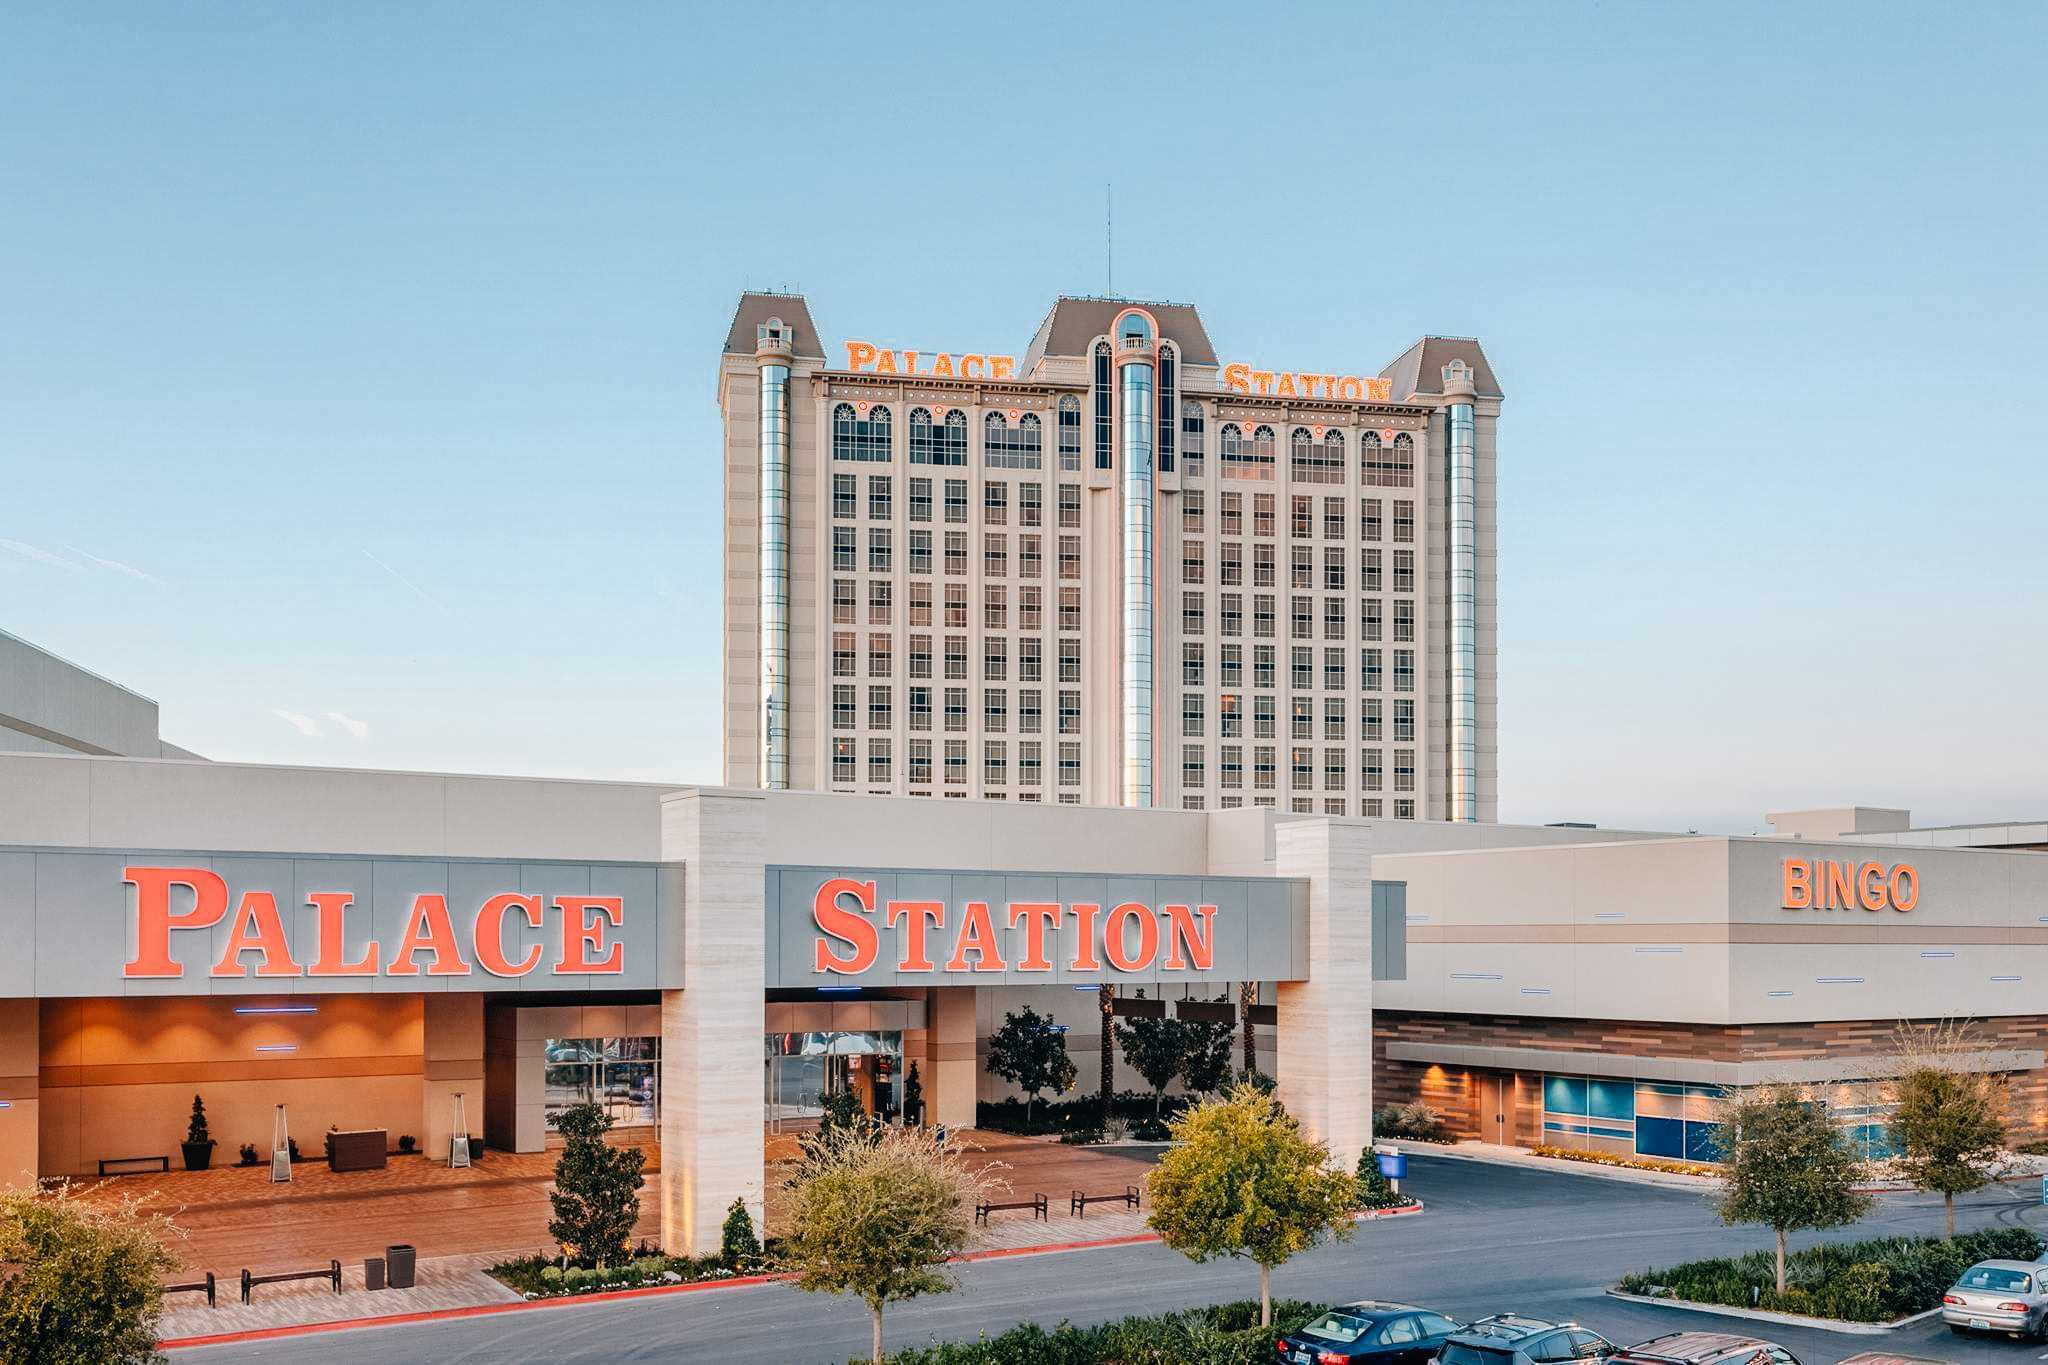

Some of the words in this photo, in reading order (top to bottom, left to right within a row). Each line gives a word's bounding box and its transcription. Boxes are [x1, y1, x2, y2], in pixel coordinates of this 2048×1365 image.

[845, 340, 1015, 379] PALACE
[1223, 362, 1393, 400] STATION
[1782, 857, 1919, 911] BINGO
[123, 866, 624, 977] PALACE
[812, 877, 1219, 975] STATION
